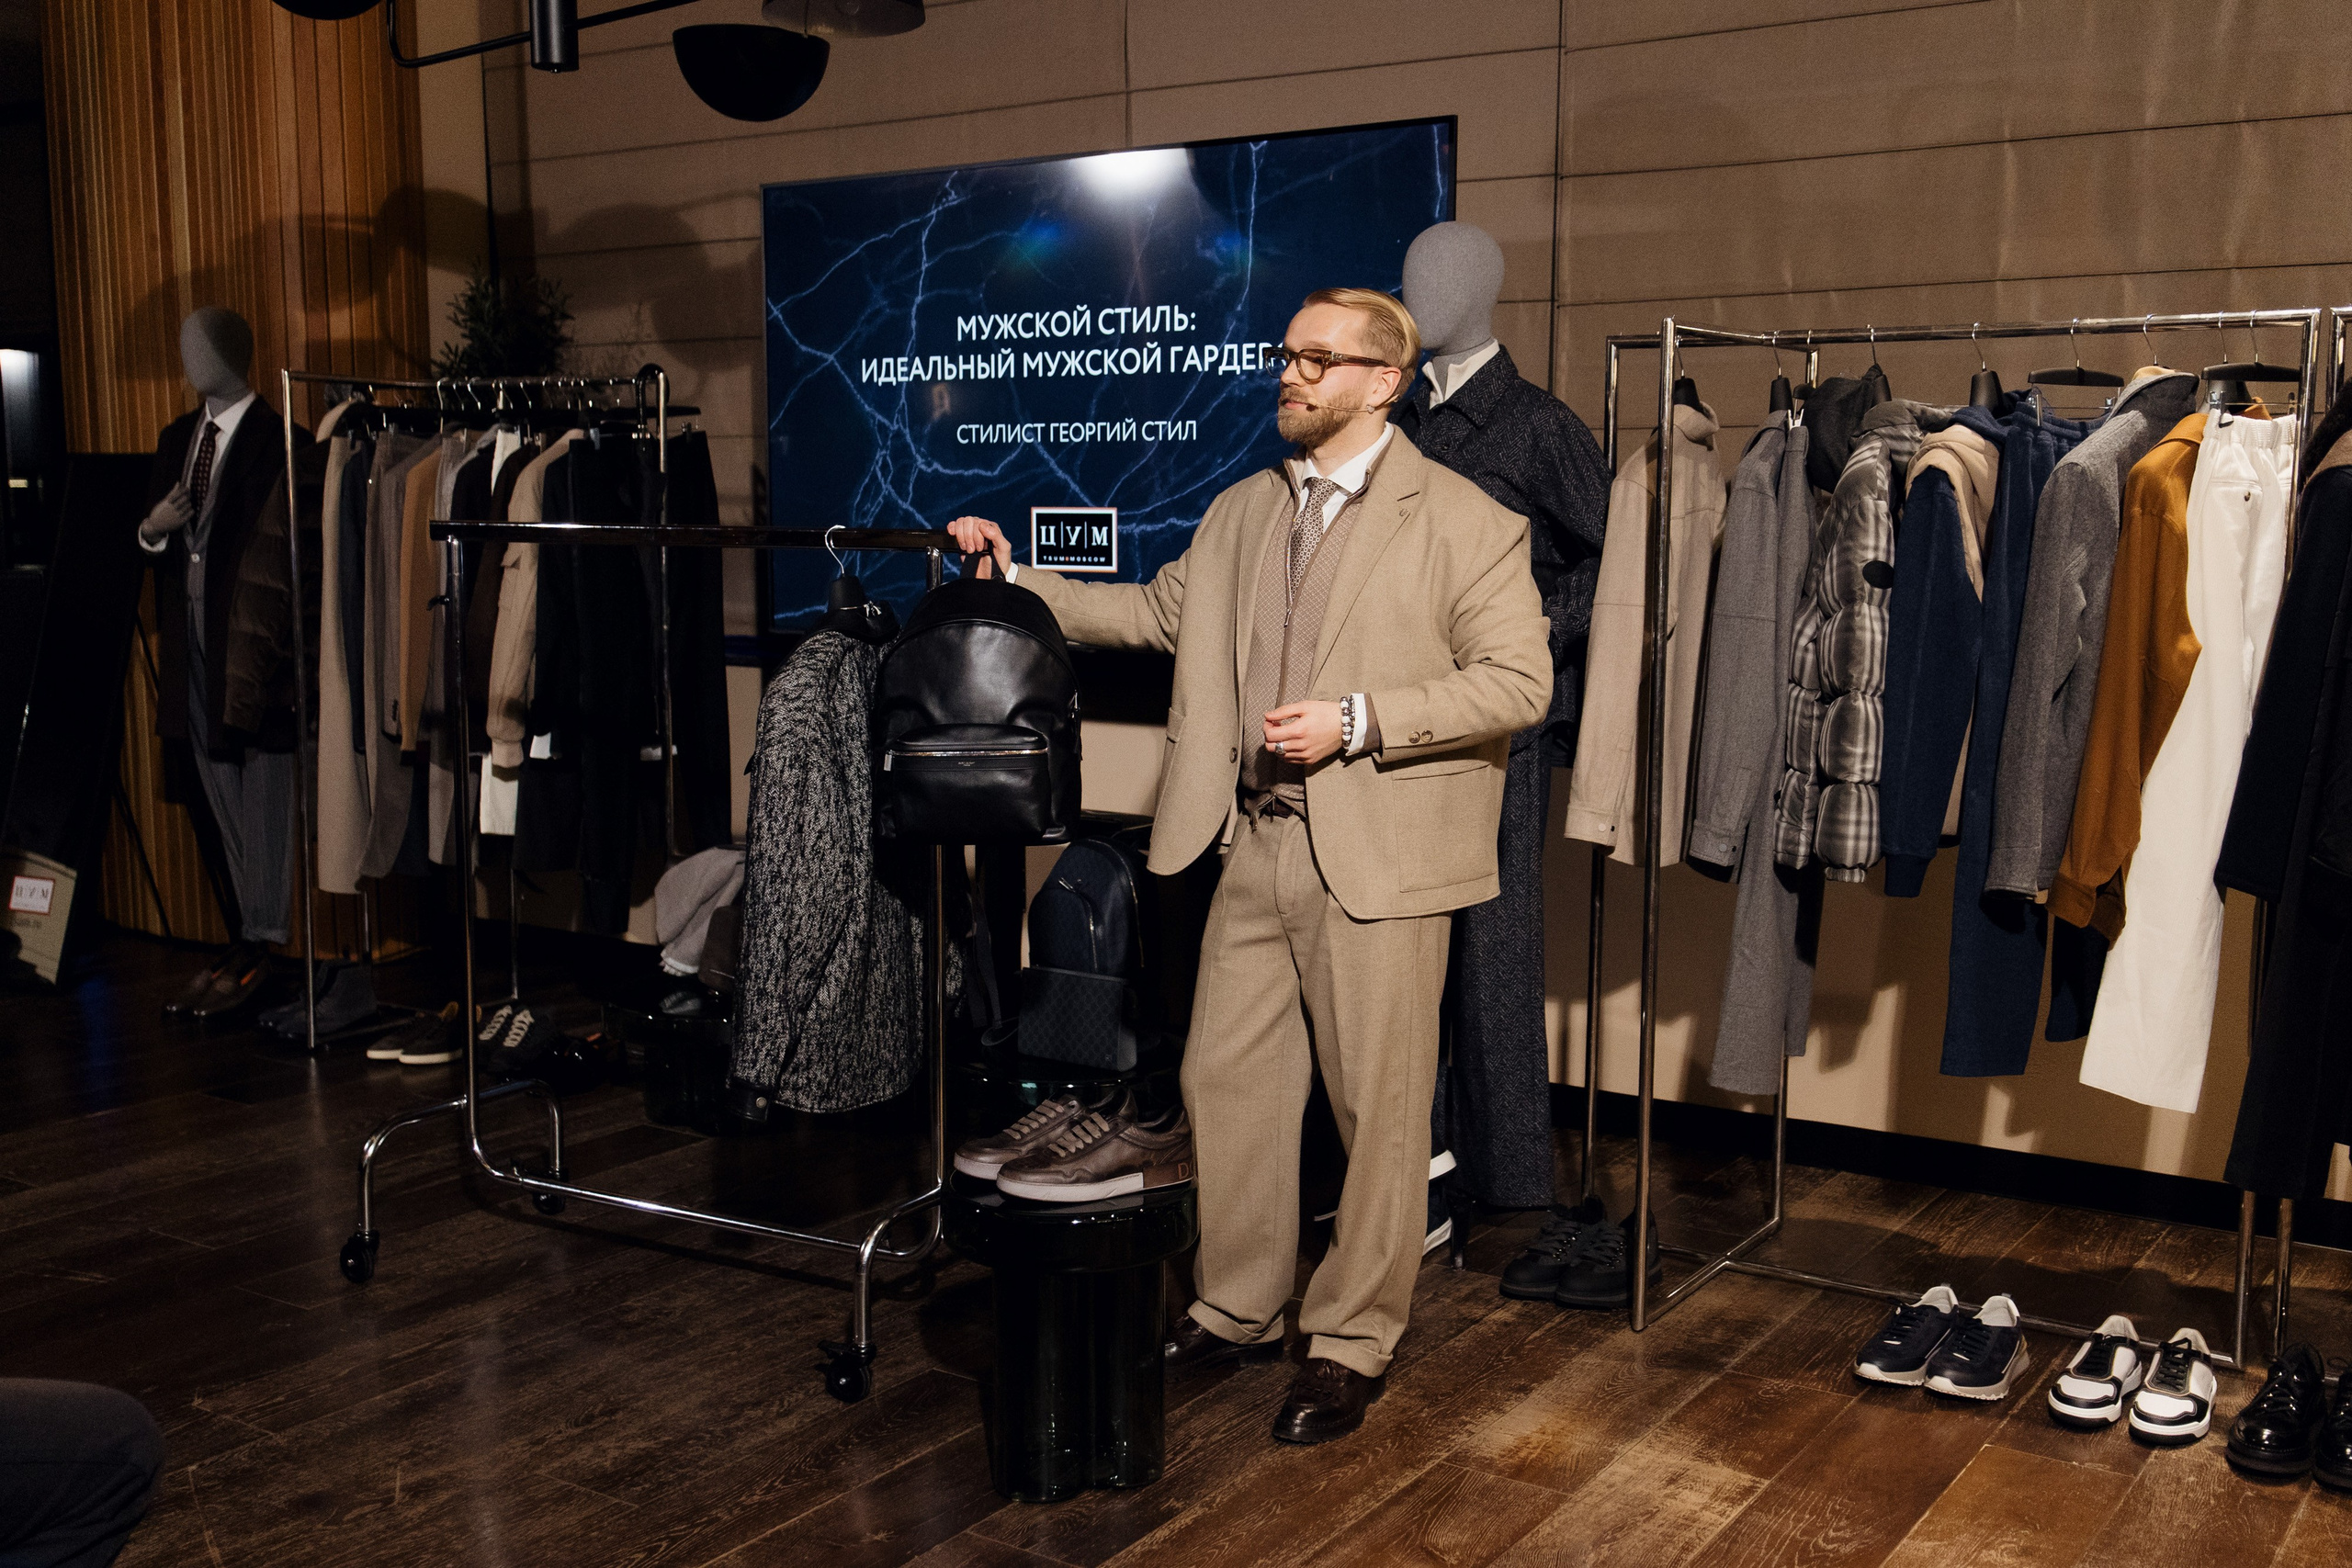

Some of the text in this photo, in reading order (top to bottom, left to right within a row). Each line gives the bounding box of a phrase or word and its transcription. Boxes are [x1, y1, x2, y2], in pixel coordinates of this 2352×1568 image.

[956, 304, 1196, 342] МУЖСКОЙ СТИЛЬ:
[862, 347, 1015, 387] ИДЕАЛЬНЫЙ
[1023, 341, 1161, 378] МУЖСКОЙ
[956, 417, 1197, 445] СТИЛИСТ ГЕОРГИЙ СТИЛ
